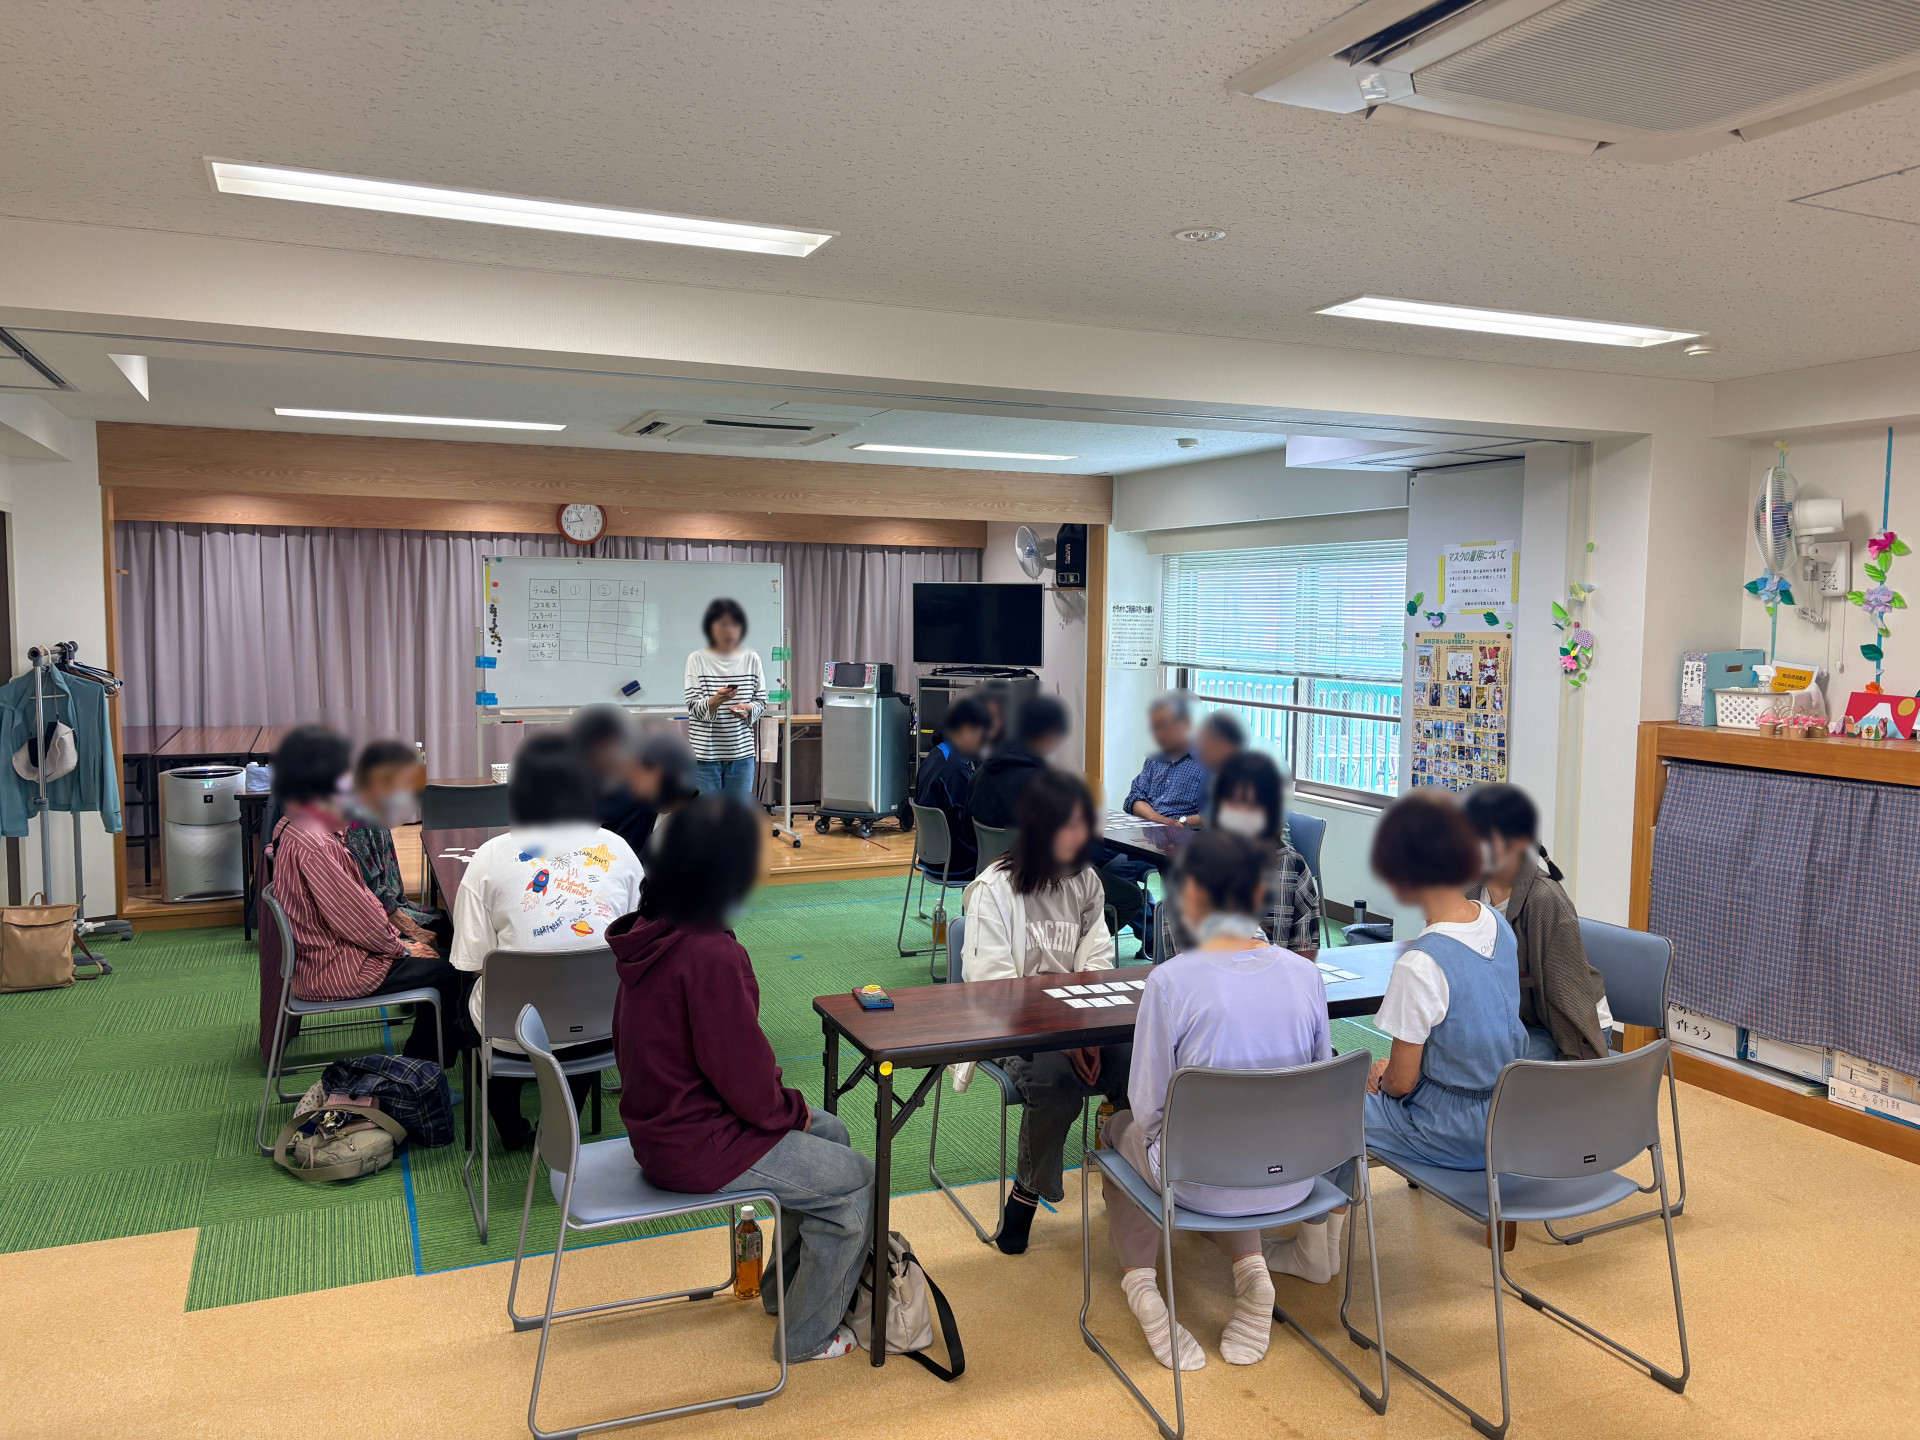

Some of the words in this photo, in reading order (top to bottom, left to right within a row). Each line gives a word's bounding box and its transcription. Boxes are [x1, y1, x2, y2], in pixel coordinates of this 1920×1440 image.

[1449, 549, 1507, 562] マスクの着用について
[531, 585, 558, 595] チーム名
[622, 586, 640, 597] 合計
[532, 651, 555, 659] いちご
[573, 850, 609, 865] STARLIGHT
[555, 882, 588, 899] BURNING
[1676, 1018, 1711, 1041] 作ろう
